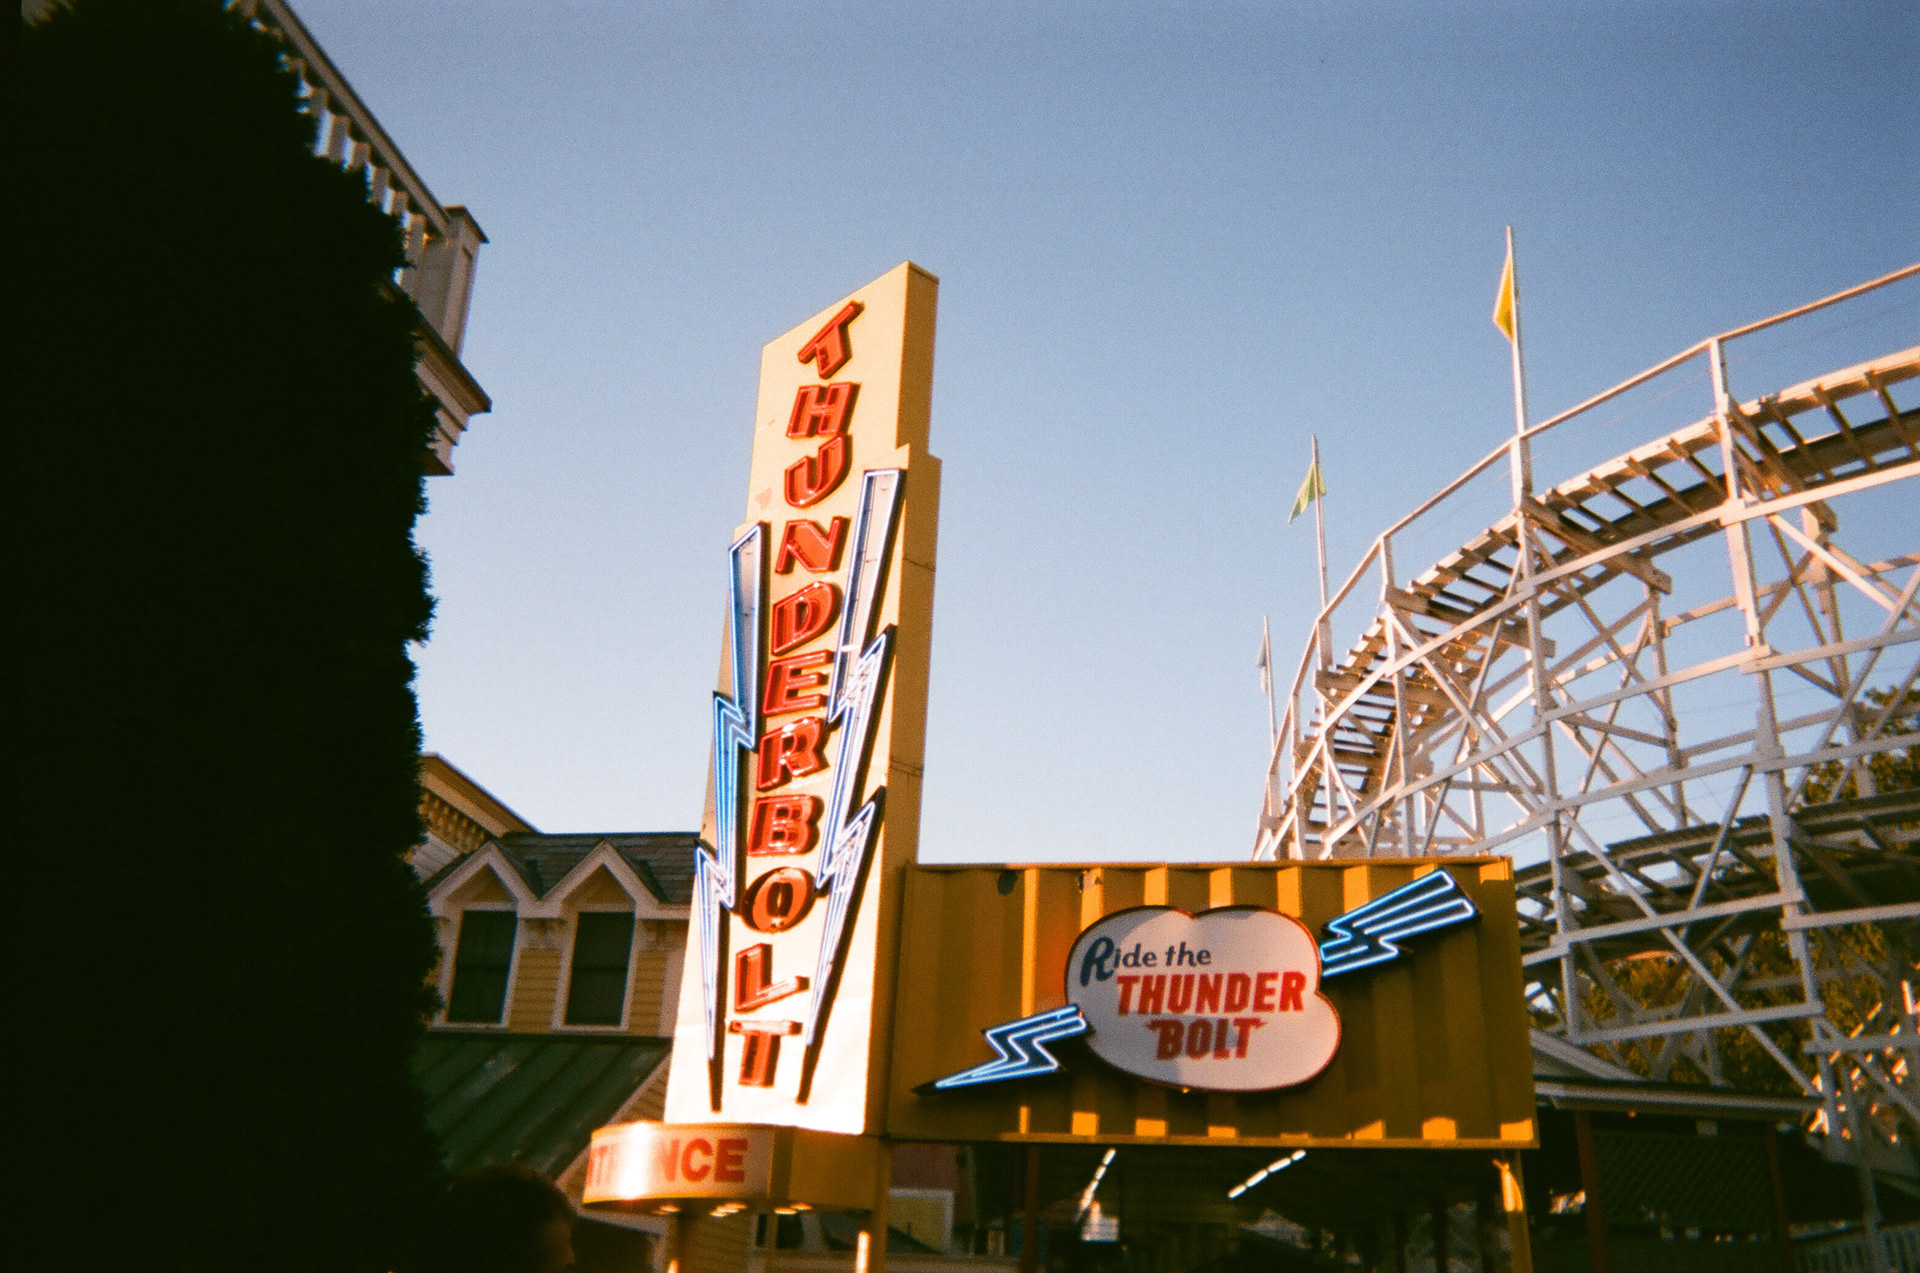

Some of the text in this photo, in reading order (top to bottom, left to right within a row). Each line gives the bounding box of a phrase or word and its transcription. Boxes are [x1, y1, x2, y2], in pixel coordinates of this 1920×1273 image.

[727, 300, 865, 1088] THUNDERBOLT
[1080, 936, 1211, 986] Ride the
[1117, 971, 1307, 1015] THUNDER
[1145, 1017, 1267, 1060] BOLT
